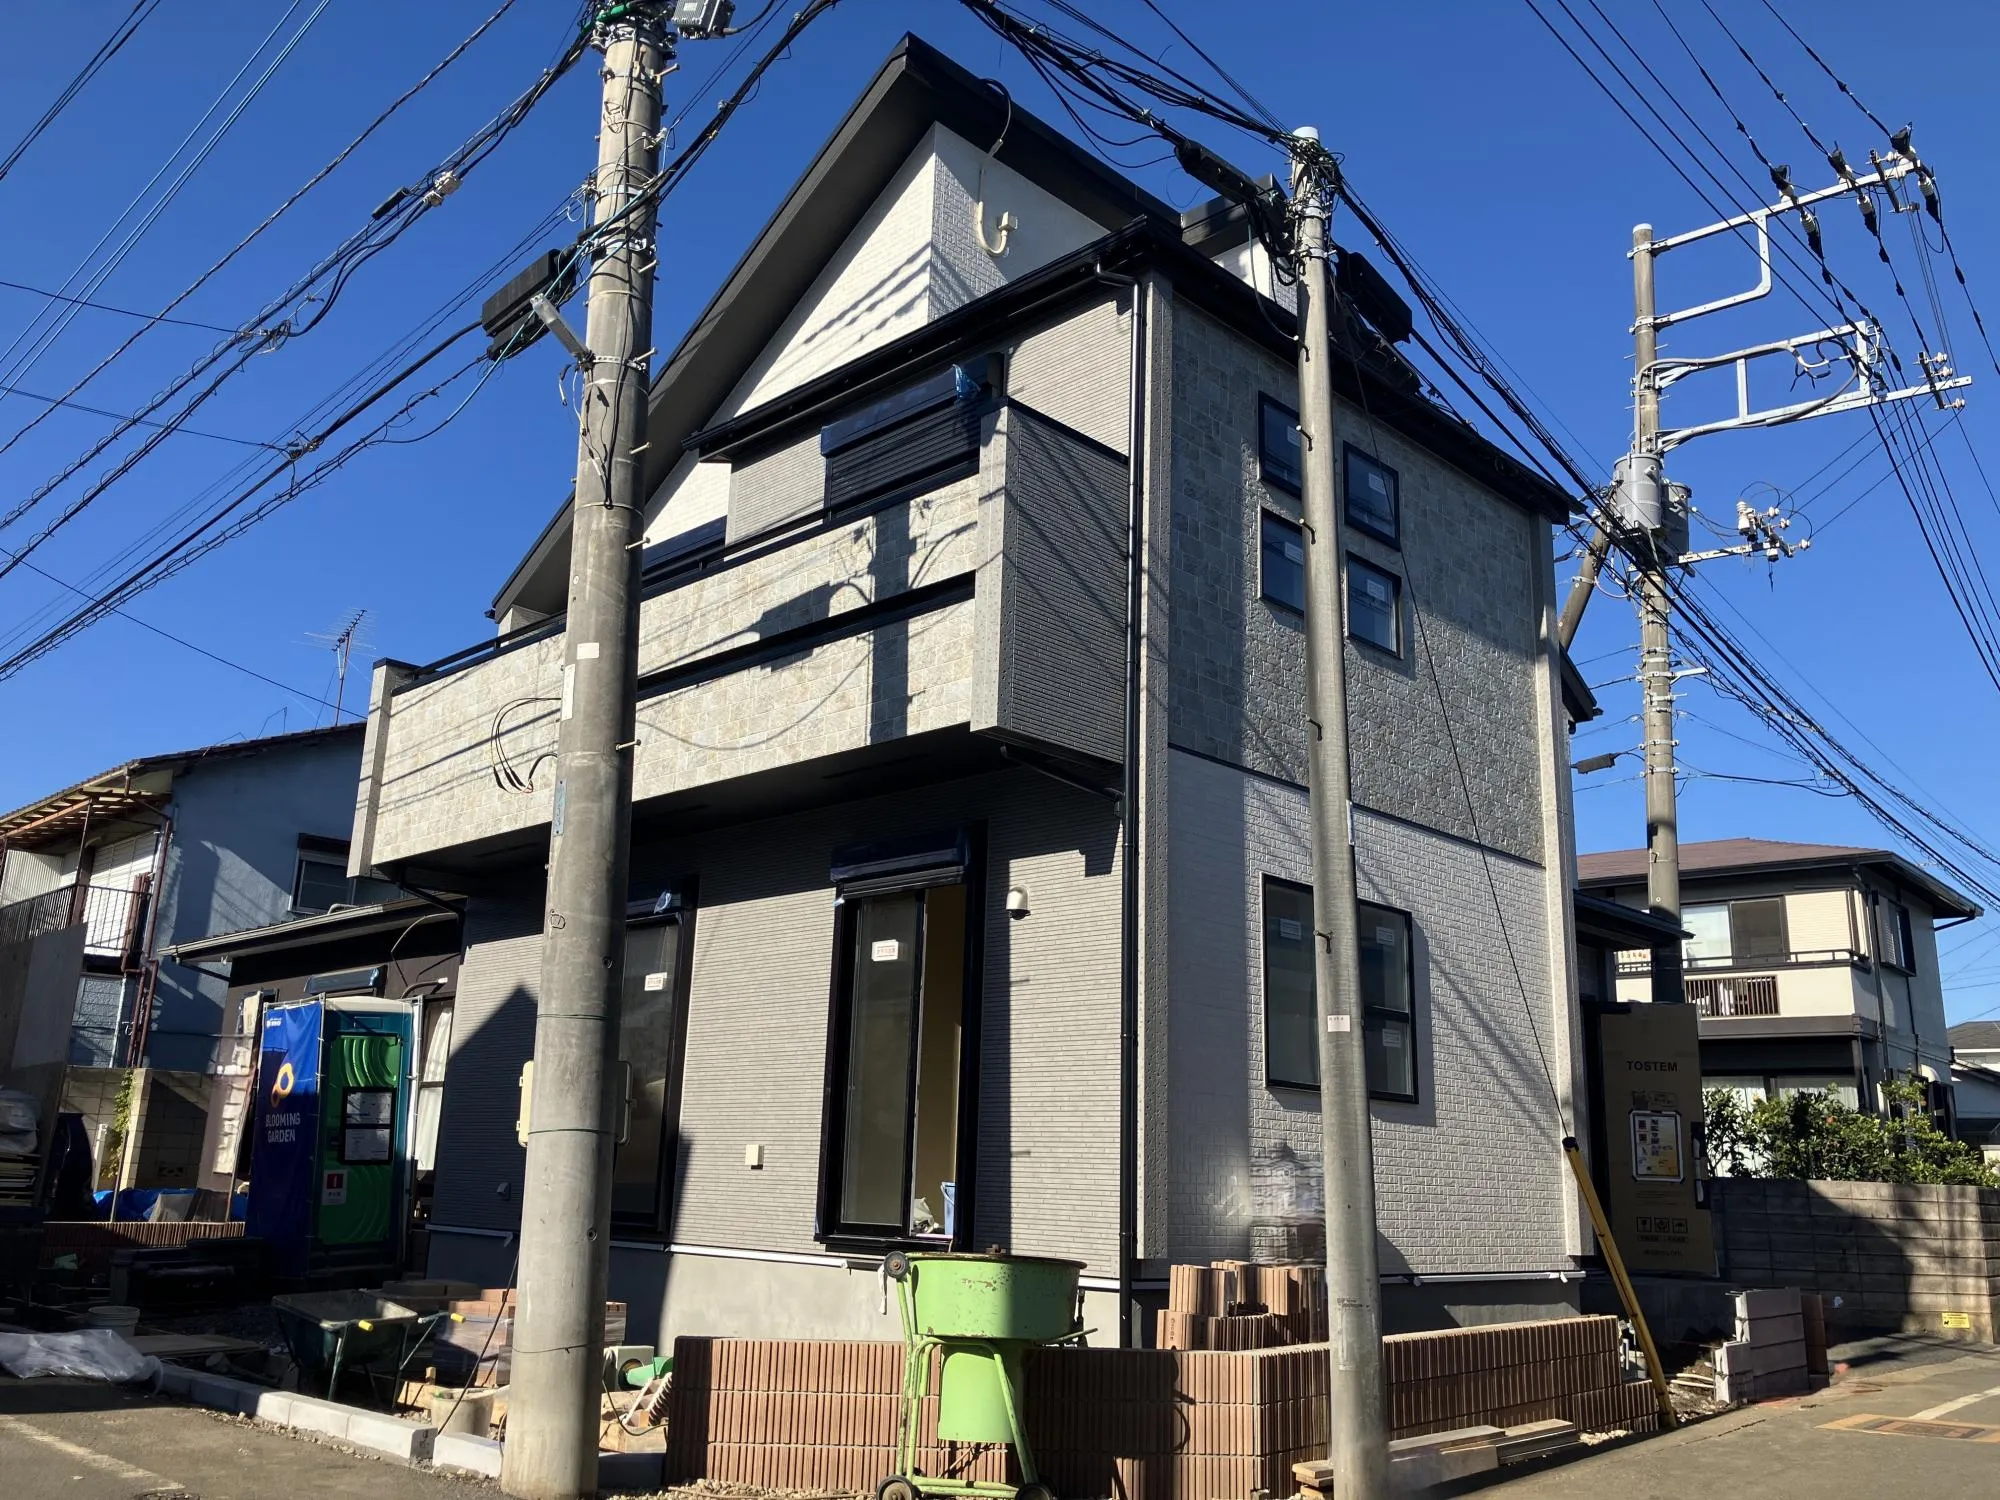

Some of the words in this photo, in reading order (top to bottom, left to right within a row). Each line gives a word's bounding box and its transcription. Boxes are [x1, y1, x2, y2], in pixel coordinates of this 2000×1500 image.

[1626, 1060, 1678, 1073] TOSTEM
[265, 1112, 301, 1127] BLOOMING
[267, 1128, 296, 1144] GARDEN
